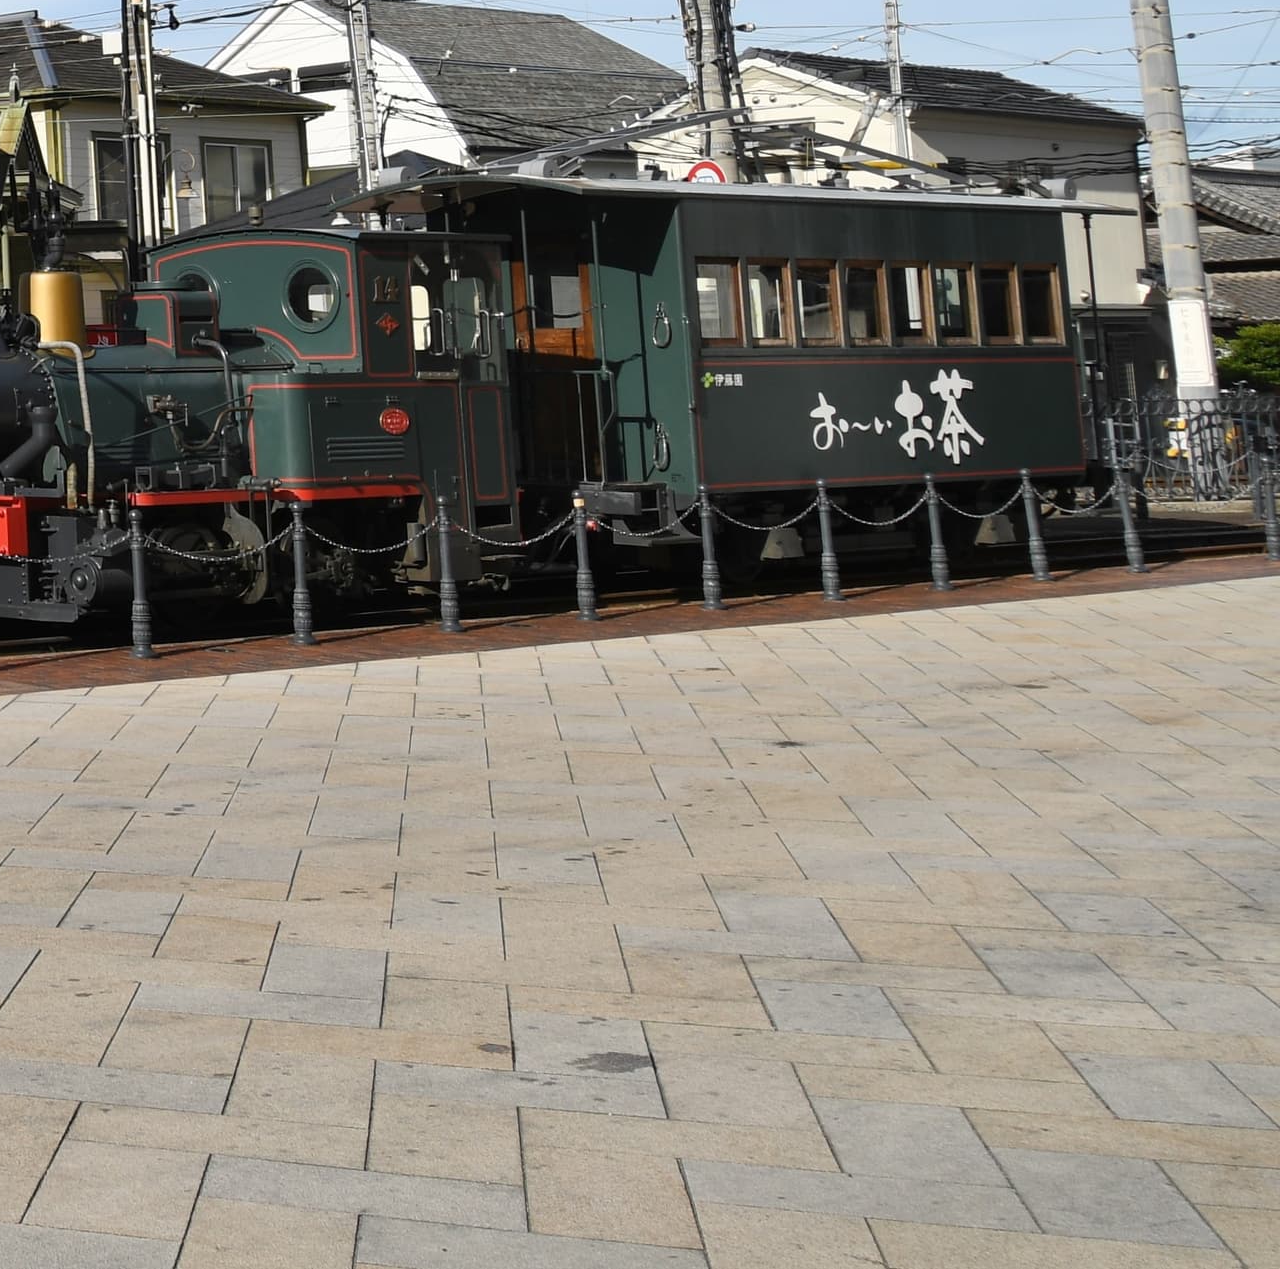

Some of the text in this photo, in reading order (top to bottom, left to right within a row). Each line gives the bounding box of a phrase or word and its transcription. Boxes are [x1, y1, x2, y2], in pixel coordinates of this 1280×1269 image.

[372, 275, 399, 303] 14
[714, 373, 744, 387] 伊藤園
